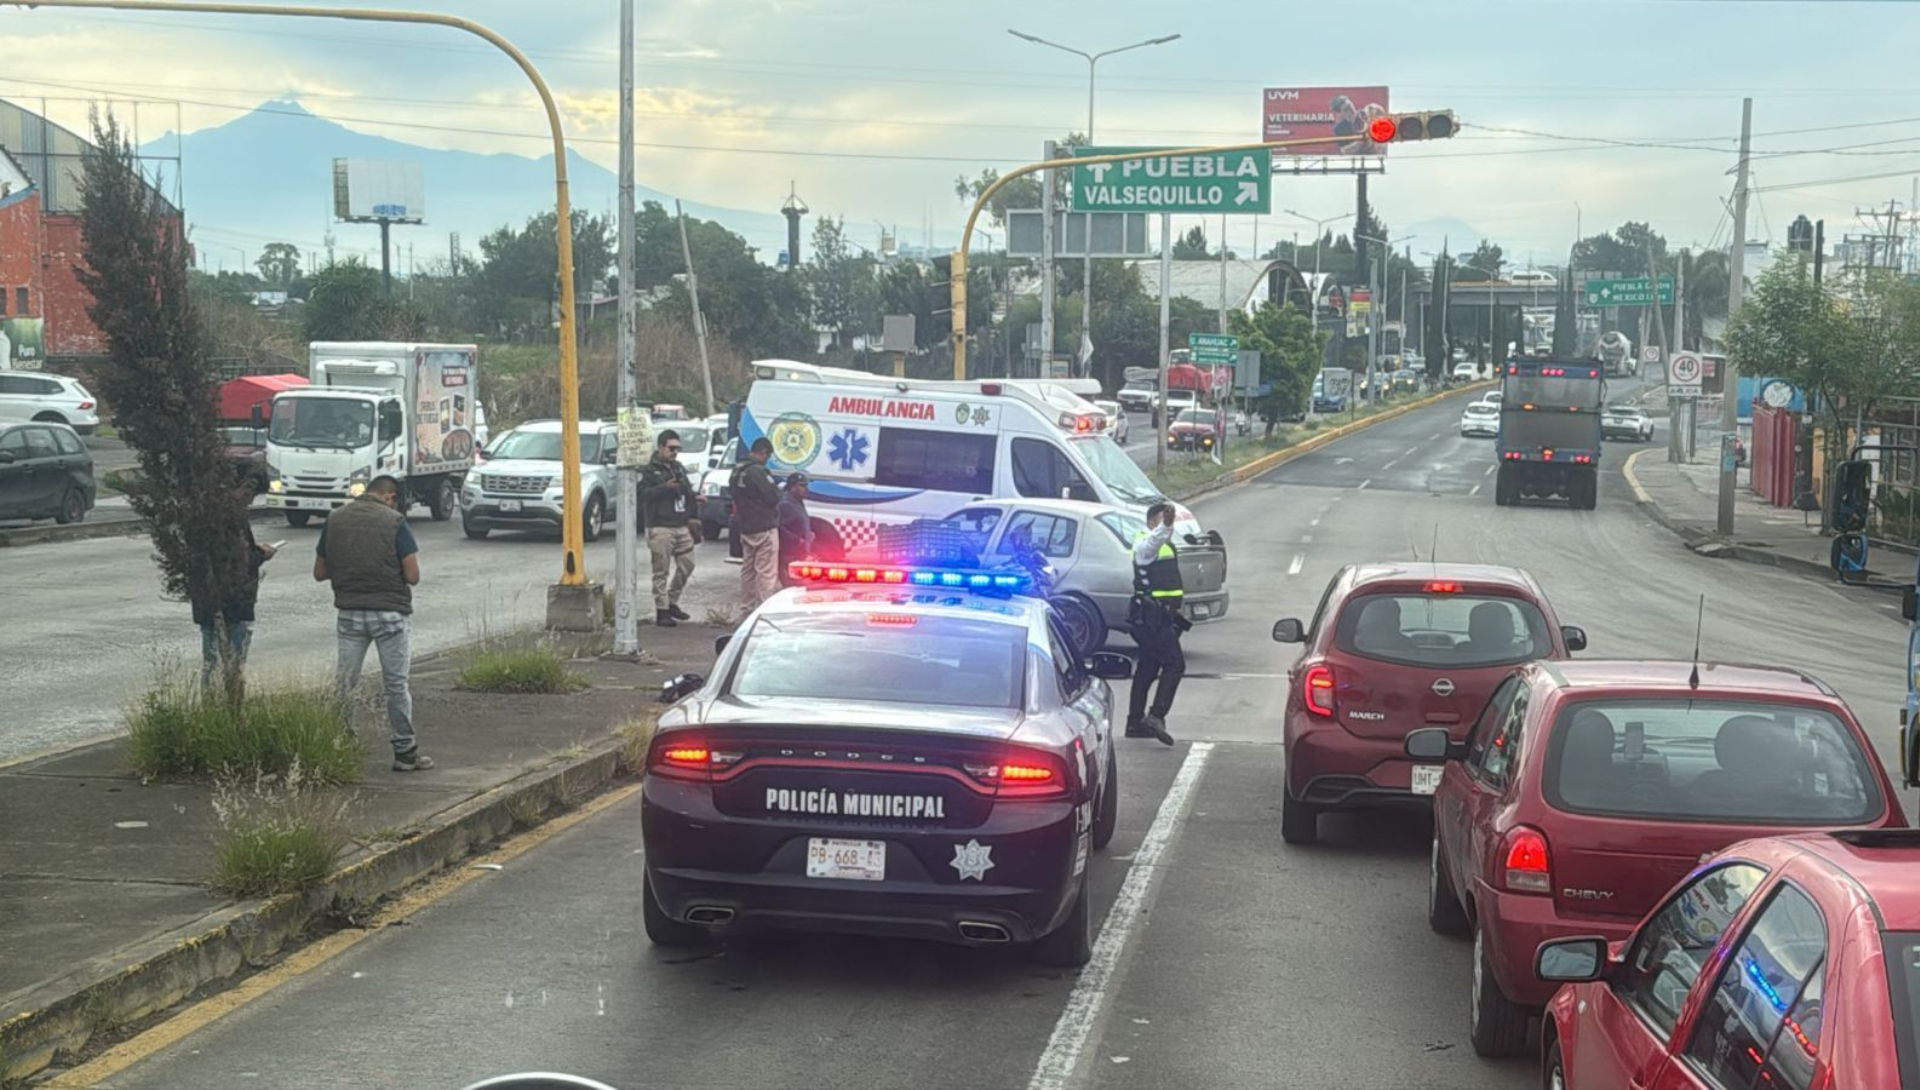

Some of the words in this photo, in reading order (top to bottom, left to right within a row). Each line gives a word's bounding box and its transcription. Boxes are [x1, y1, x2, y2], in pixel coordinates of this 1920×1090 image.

[1267, 91, 1299, 100] UVM
[1268, 113, 1335, 122] VETERINARIA
[1122, 156, 1260, 177] PUEBLA
[1084, 186, 1223, 205] VALSEQUILLO
[1612, 283, 1643, 291] PUEBLA
[1679, 360, 1694, 372] 40
[828, 396, 935, 420] AMBULANCIA
[1349, 711, 1384, 720] MARCH
[766, 788, 838, 814] POLICÍA
[843, 793, 946, 818] MUNICIPAL
[1564, 888, 1614, 900] CHEVY
